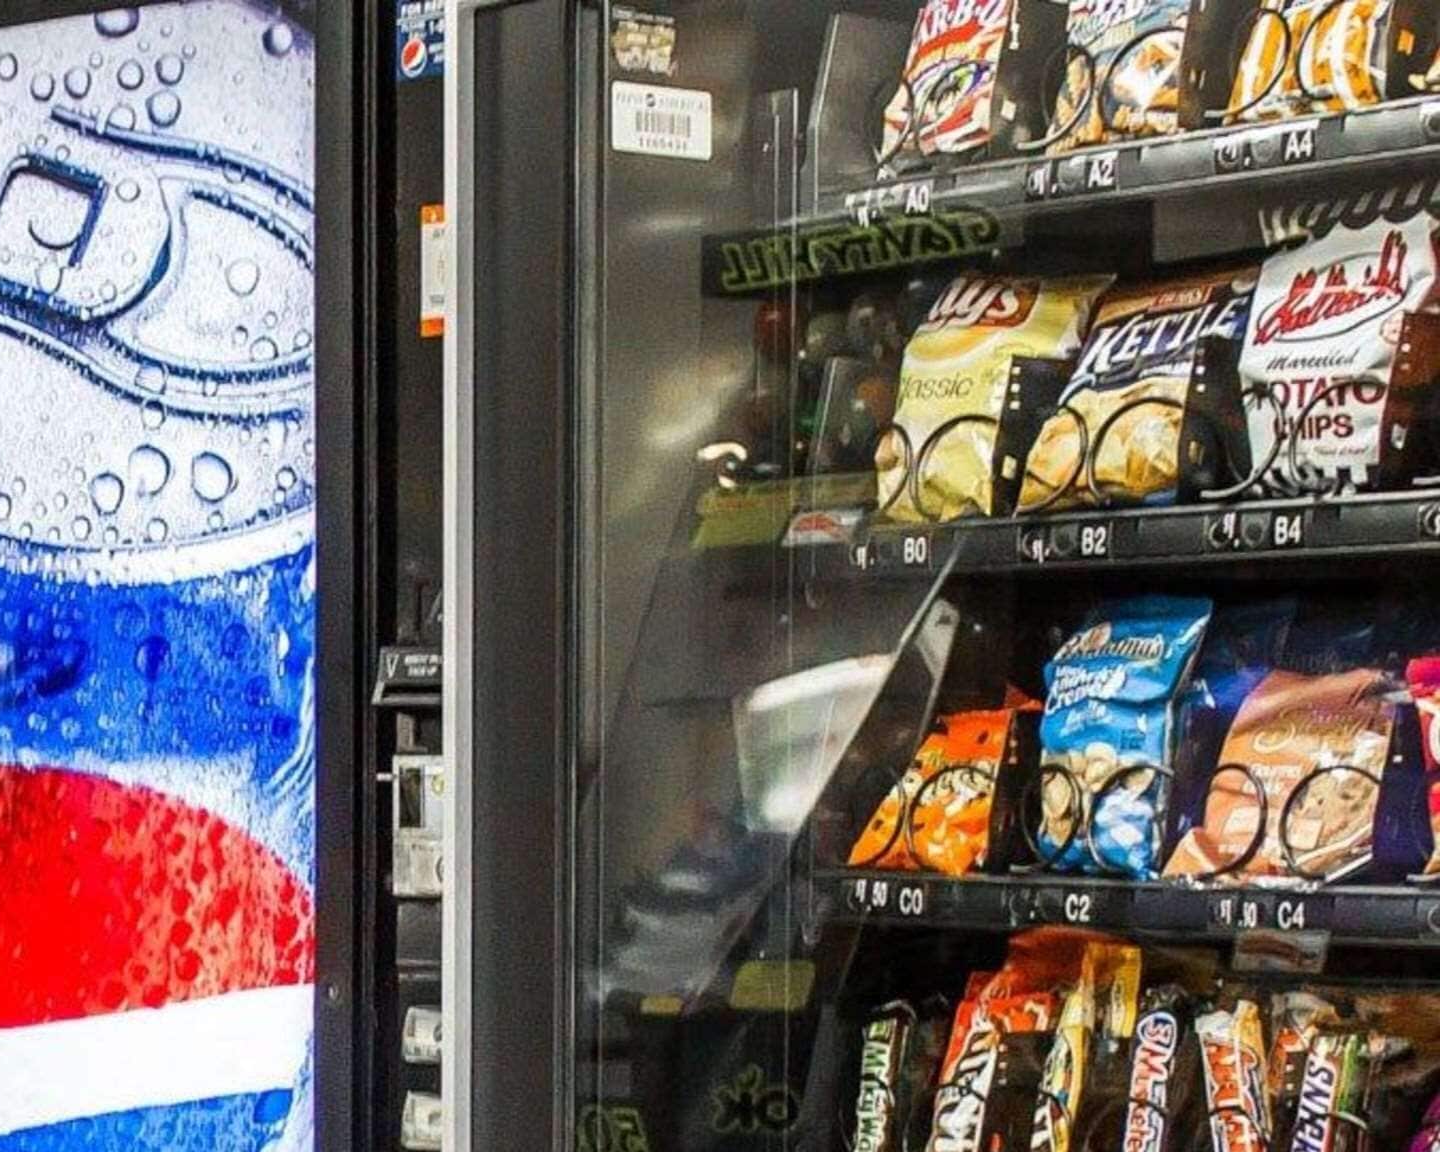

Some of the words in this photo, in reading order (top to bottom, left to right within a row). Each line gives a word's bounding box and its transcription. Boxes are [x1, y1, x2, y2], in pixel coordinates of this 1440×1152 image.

[1284, 132, 1313, 160] A4
[1088, 160, 1114, 188] A2
[905, 183, 930, 213] A0
[1070, 296, 1252, 381] KETTLE
[1082, 527, 1107, 555] B2
[1275, 516, 1301, 544] B4
[904, 538, 926, 563] B0
[899, 888, 923, 915] C0
[1065, 895, 1091, 922] C2
[1277, 901, 1305, 929] C4
